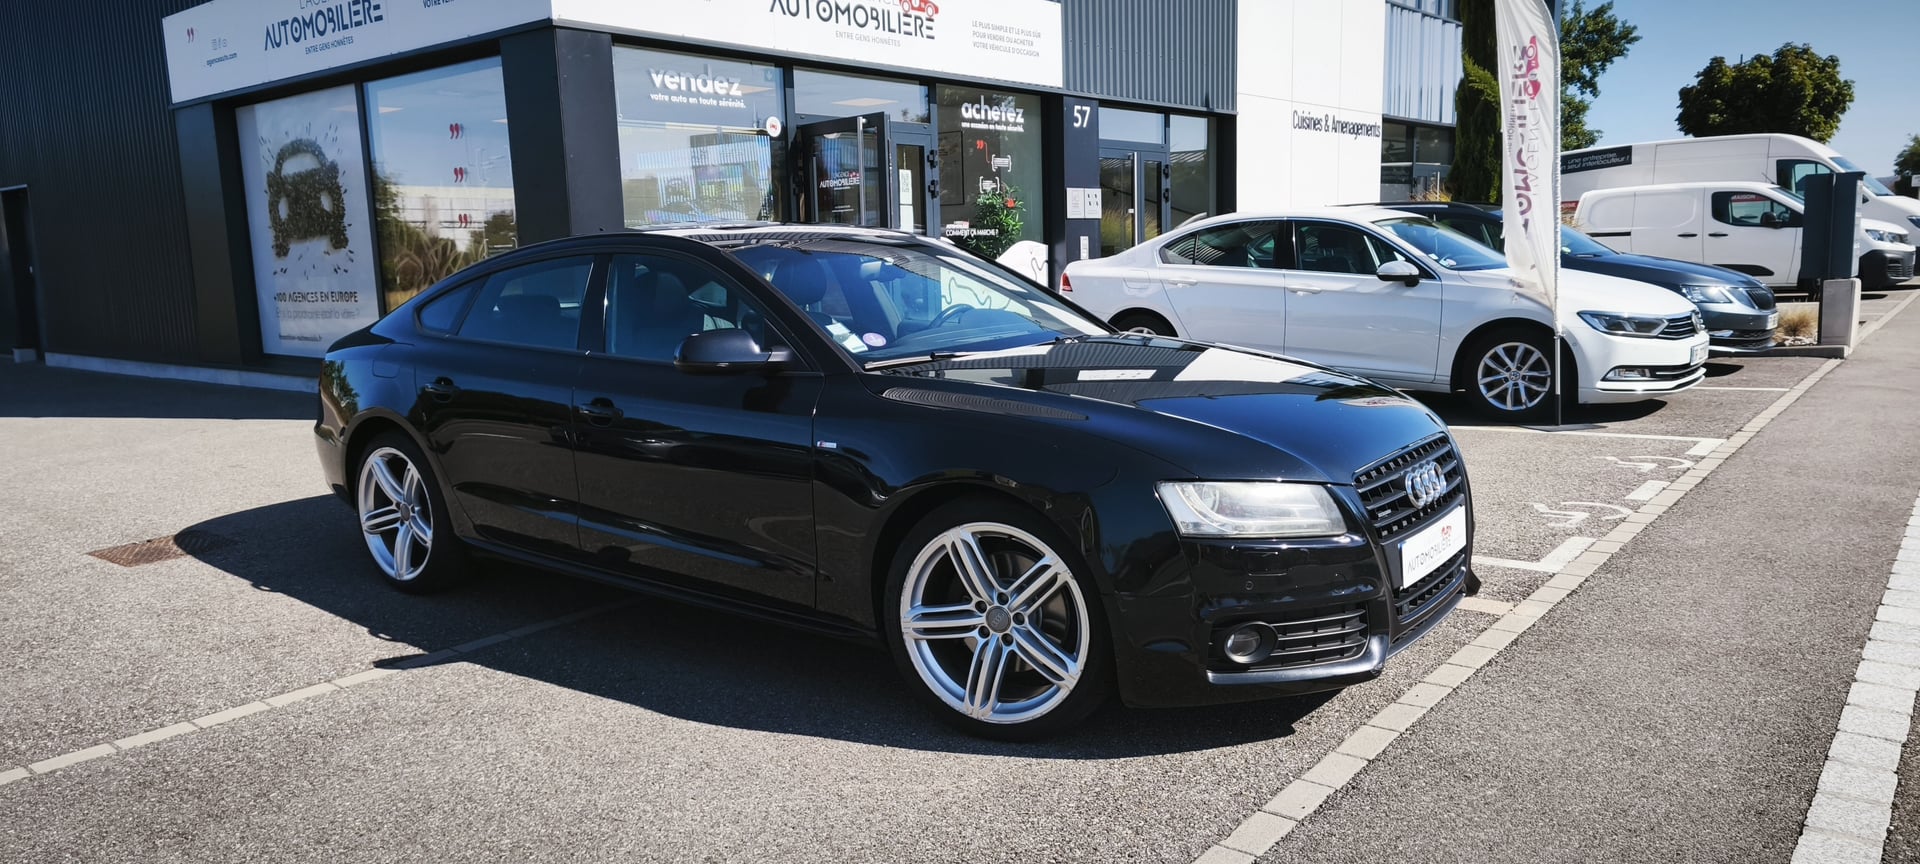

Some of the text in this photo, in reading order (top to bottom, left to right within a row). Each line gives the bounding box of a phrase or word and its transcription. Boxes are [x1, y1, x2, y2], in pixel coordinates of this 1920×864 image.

[835, 30, 853, 40] ENTRE
[855, 34, 870, 43] GENS
[972, 30, 986, 39] POUR
[305, 46, 319, 55] ENTRE
[319, 42, 331, 52] GENS
[649, 64, 742, 97] vendez
[650, 93, 669, 102] votre
[671, 95, 687, 103] auto
[700, 97, 717, 106] toute
[961, 95, 1024, 123] achetez
[1073, 105, 1091, 128] 57
[1292, 110, 1323, 132] Cuisines
[1324, 113, 1330, 132] &
[288, 291, 319, 303] AGENCES
[320, 291, 329, 303] EN
[330, 291, 359, 303] EUROPE
